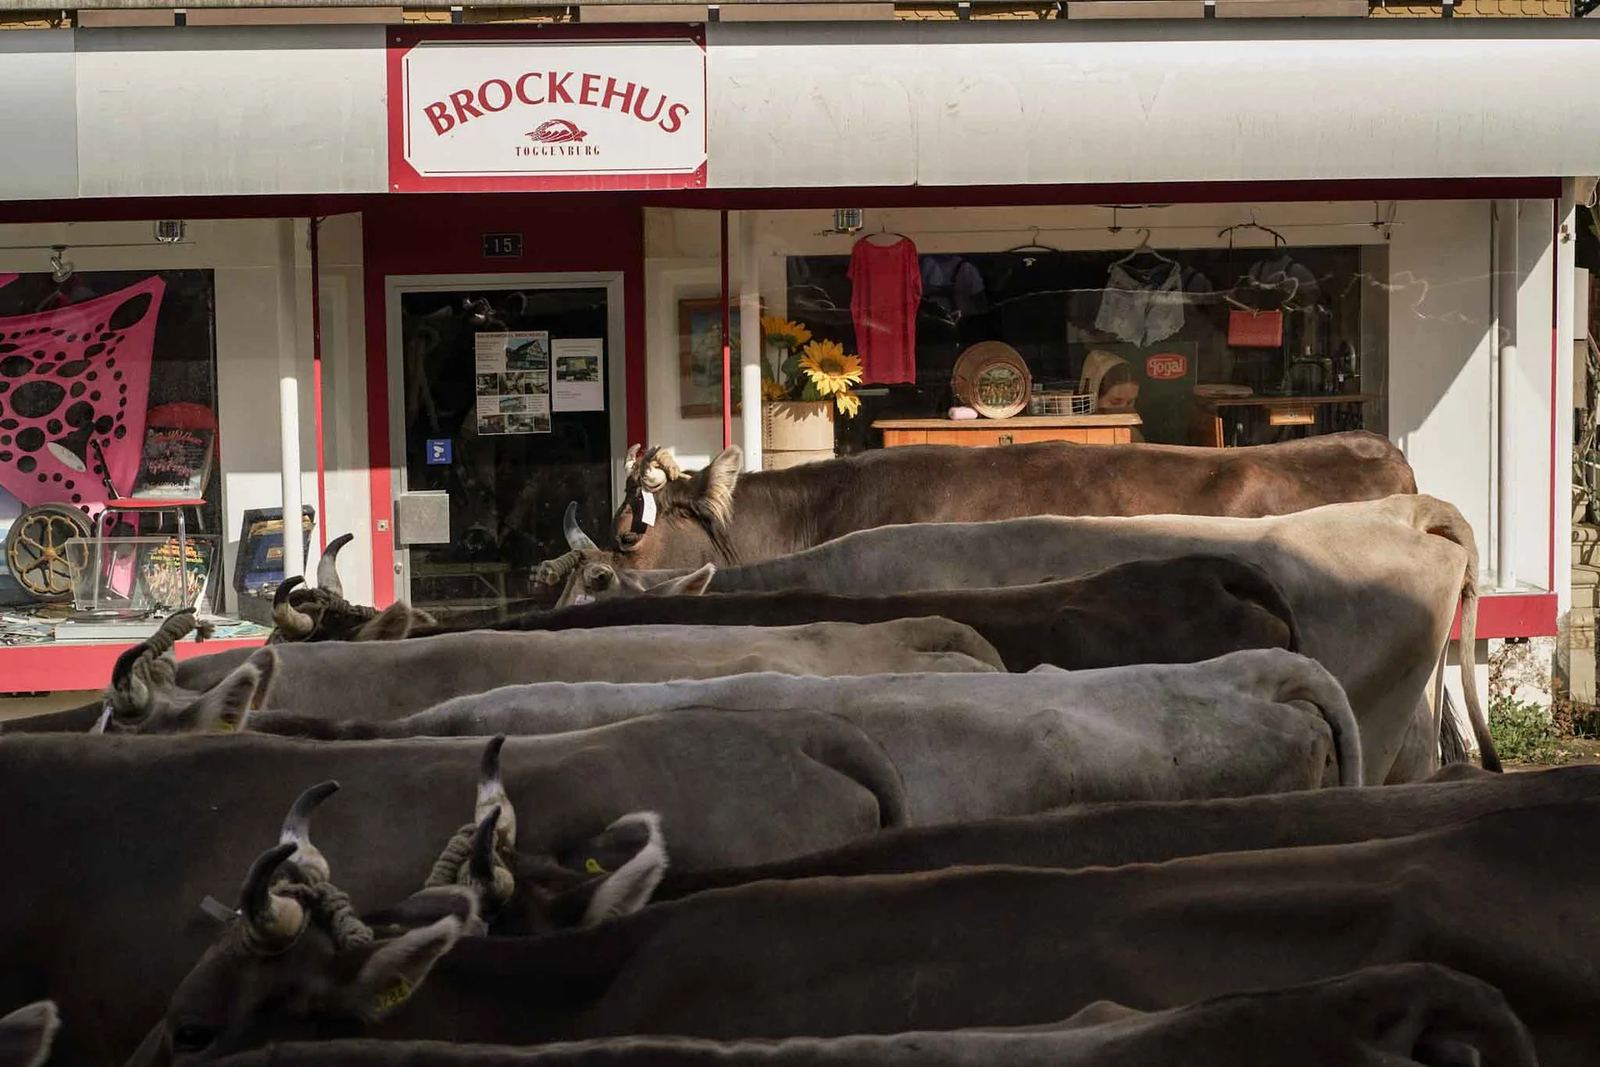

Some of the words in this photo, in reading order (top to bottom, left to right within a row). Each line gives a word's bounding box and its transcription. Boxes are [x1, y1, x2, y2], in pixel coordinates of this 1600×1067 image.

[423, 71, 690, 136] BROCKEHUS
[515, 145, 600, 157] TOGGENBURG
[495, 238, 512, 253] 15
